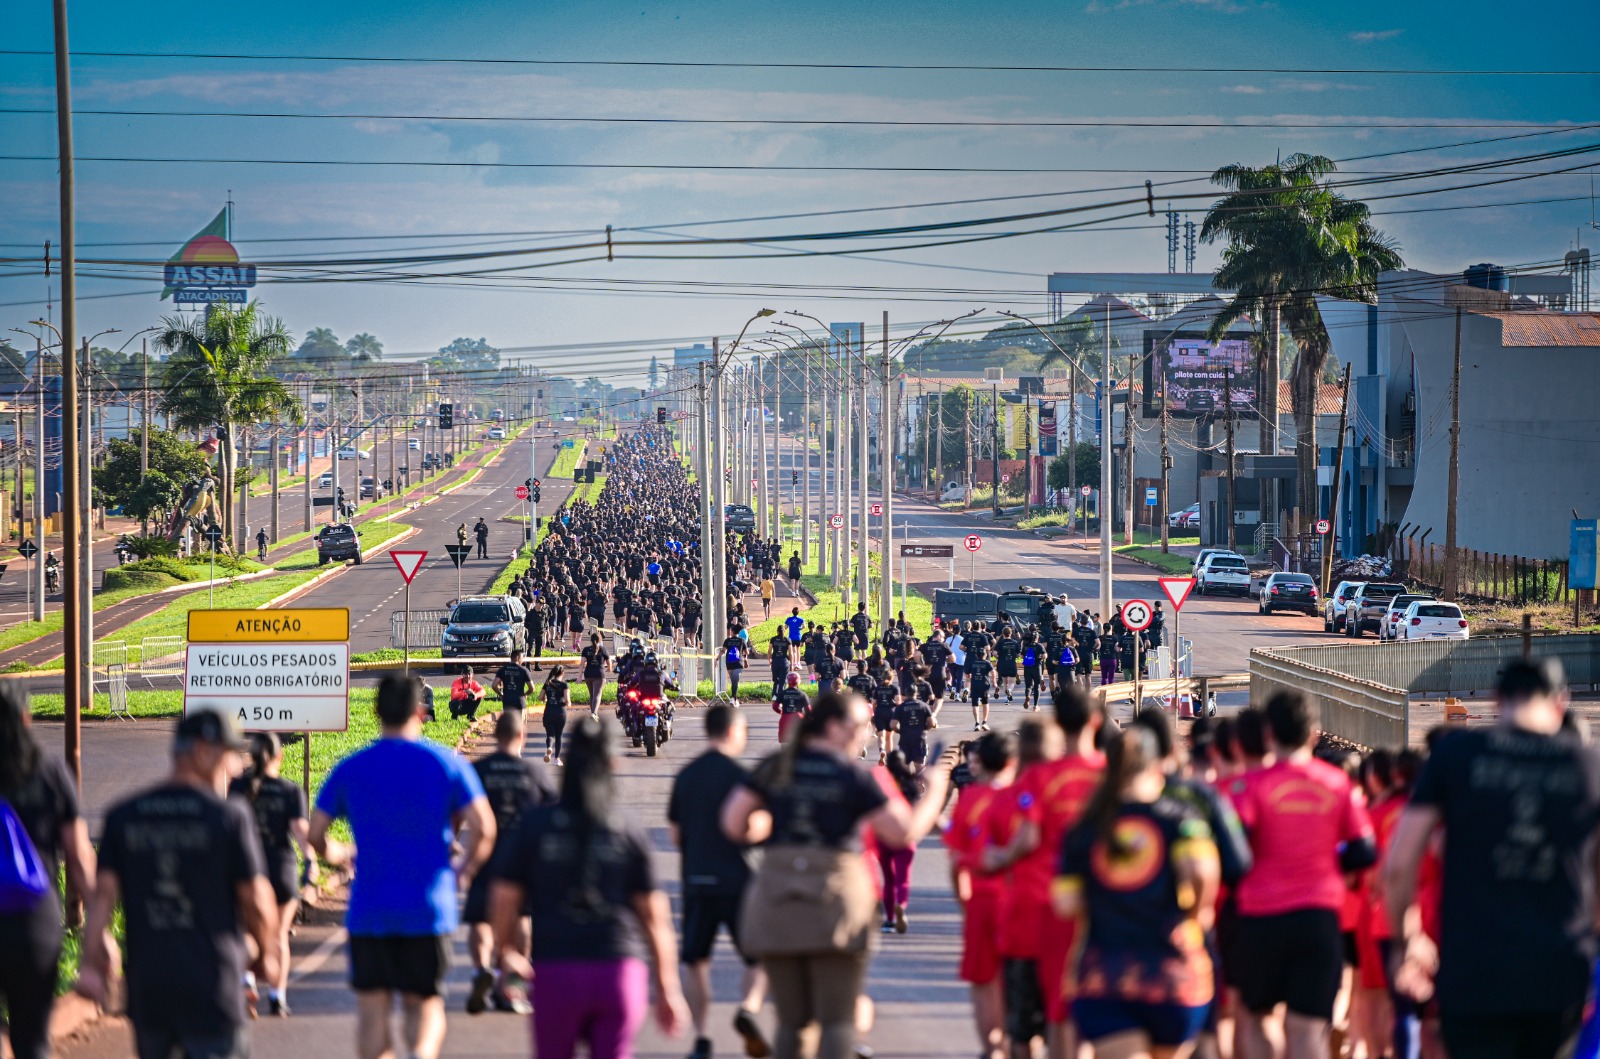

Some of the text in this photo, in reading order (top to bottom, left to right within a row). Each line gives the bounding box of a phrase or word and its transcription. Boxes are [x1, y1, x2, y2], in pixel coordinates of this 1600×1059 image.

[177, 292, 243, 301] ATACADISTA
[1174, 370, 1193, 380] pilote
[235, 616, 301, 634] ATENÇÃO
[198, 650, 337, 667] VEÍCULOS PESADOS
[190, 671, 342, 687] RETORNO OBRIGATÓRIO
[237, 706, 293, 721] A 50 m
